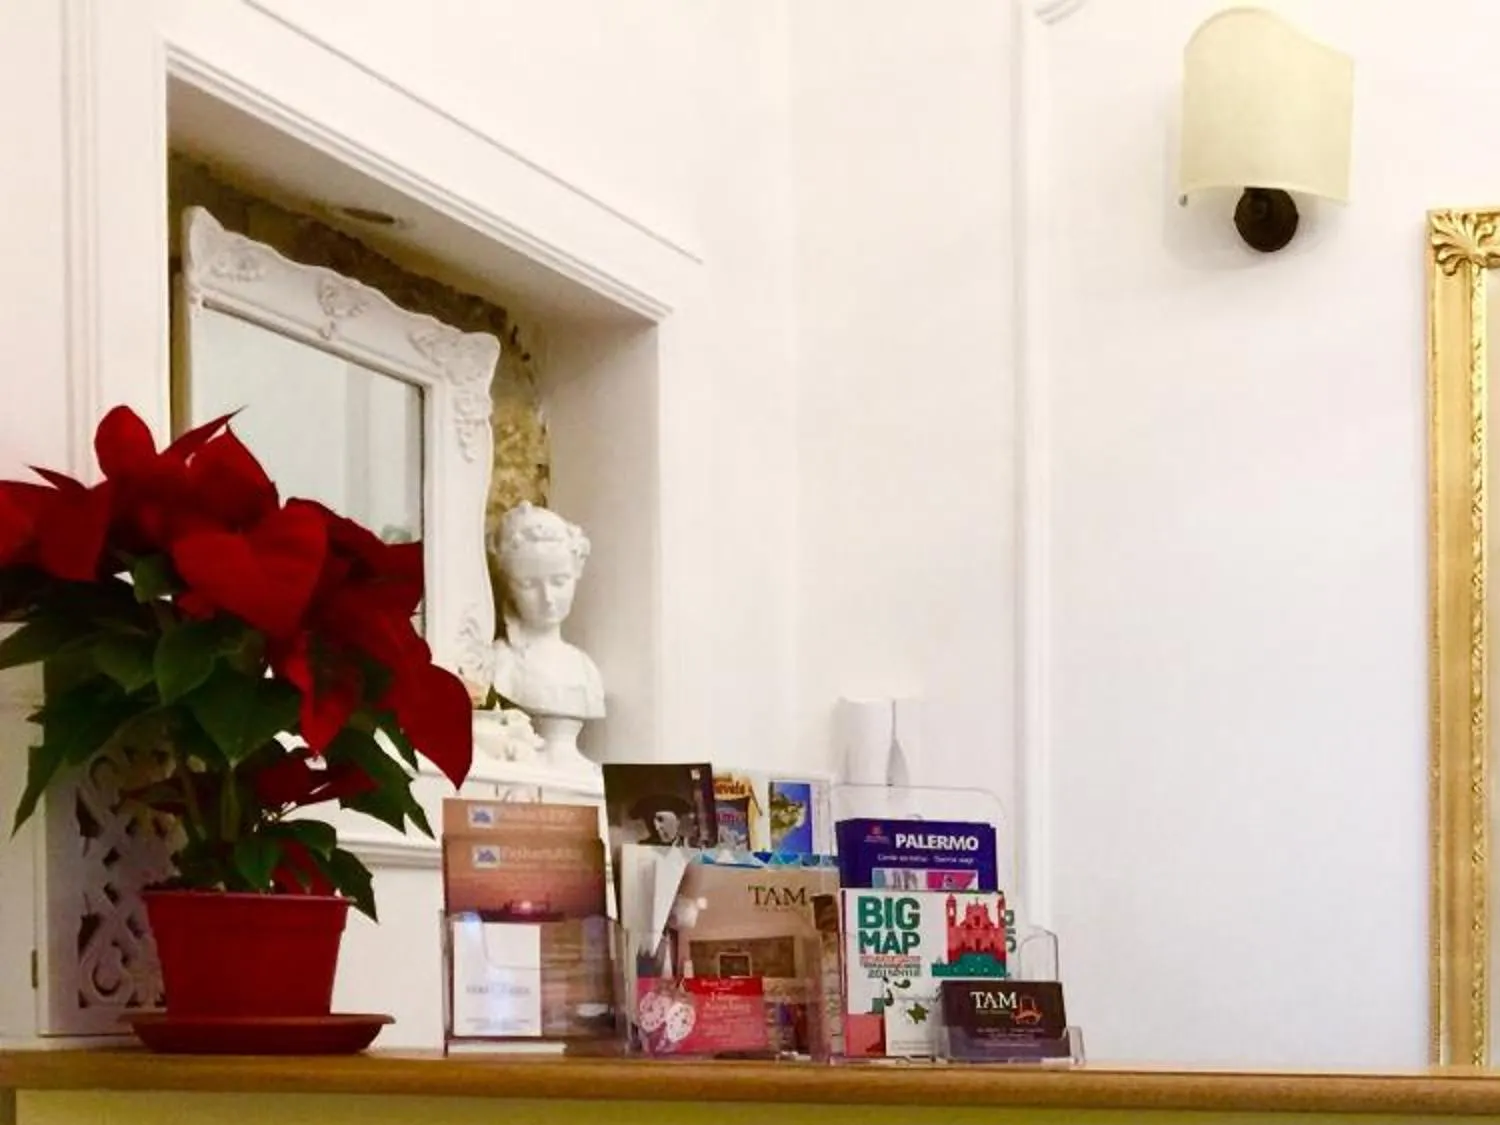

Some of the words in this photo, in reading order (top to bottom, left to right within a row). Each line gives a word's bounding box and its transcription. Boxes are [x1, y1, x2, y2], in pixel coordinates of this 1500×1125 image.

[895, 833, 980, 851] PALERMO
[747, 884, 807, 906] TAM
[857, 895, 921, 930] BIG
[858, 930, 921, 955] MAP
[969, 991, 1018, 1009] TAM
